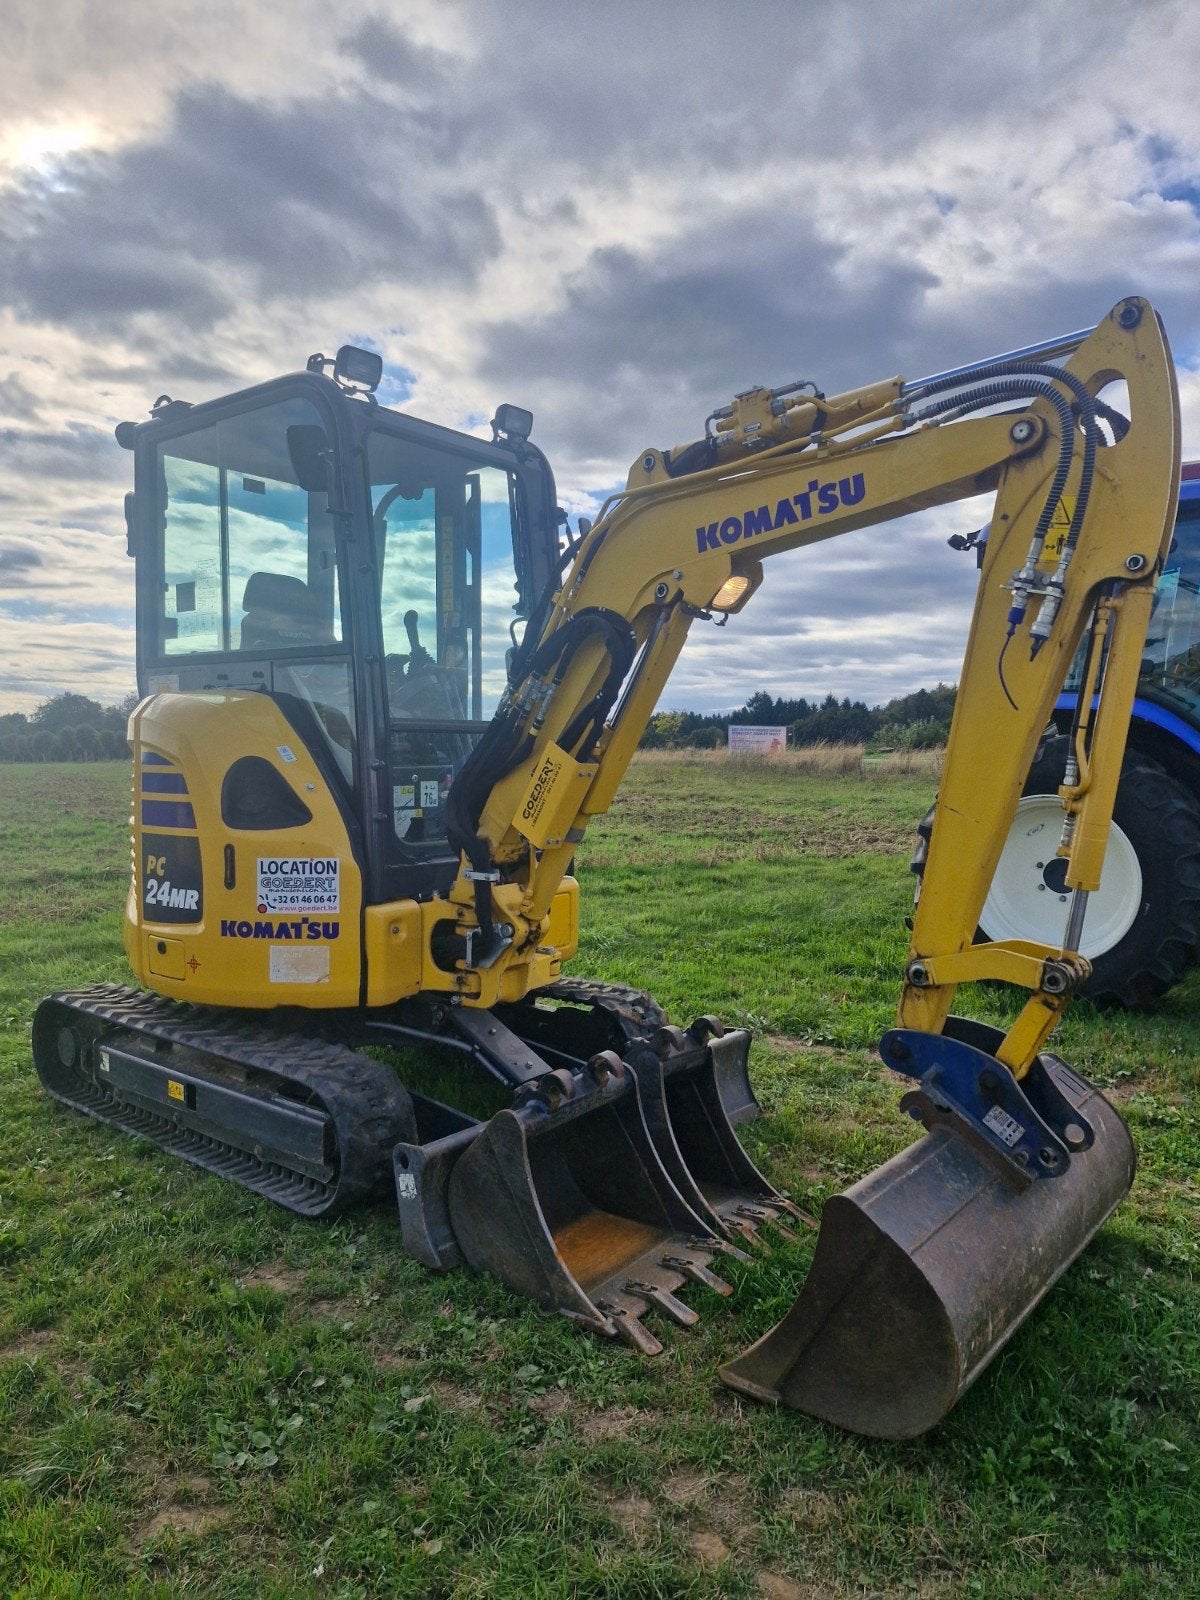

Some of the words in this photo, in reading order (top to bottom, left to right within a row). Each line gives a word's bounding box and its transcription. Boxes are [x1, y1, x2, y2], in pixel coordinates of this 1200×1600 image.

[696, 473, 866, 553] KOMATSU
[522, 756, 554, 819] GOEDERT
[146, 854, 167, 876] PC
[145, 878, 200, 910] 24MR
[261, 877, 336, 891] GOEDERT
[273, 895, 288, 904] +32
[290, 895, 299, 904] 61
[301, 895, 313, 904] 46
[313, 895, 325, 904] 06
[326, 894, 338, 903] 47
[278, 904, 338, 913] www.goedert.be
[221, 916, 340, 940] KOMATSU
